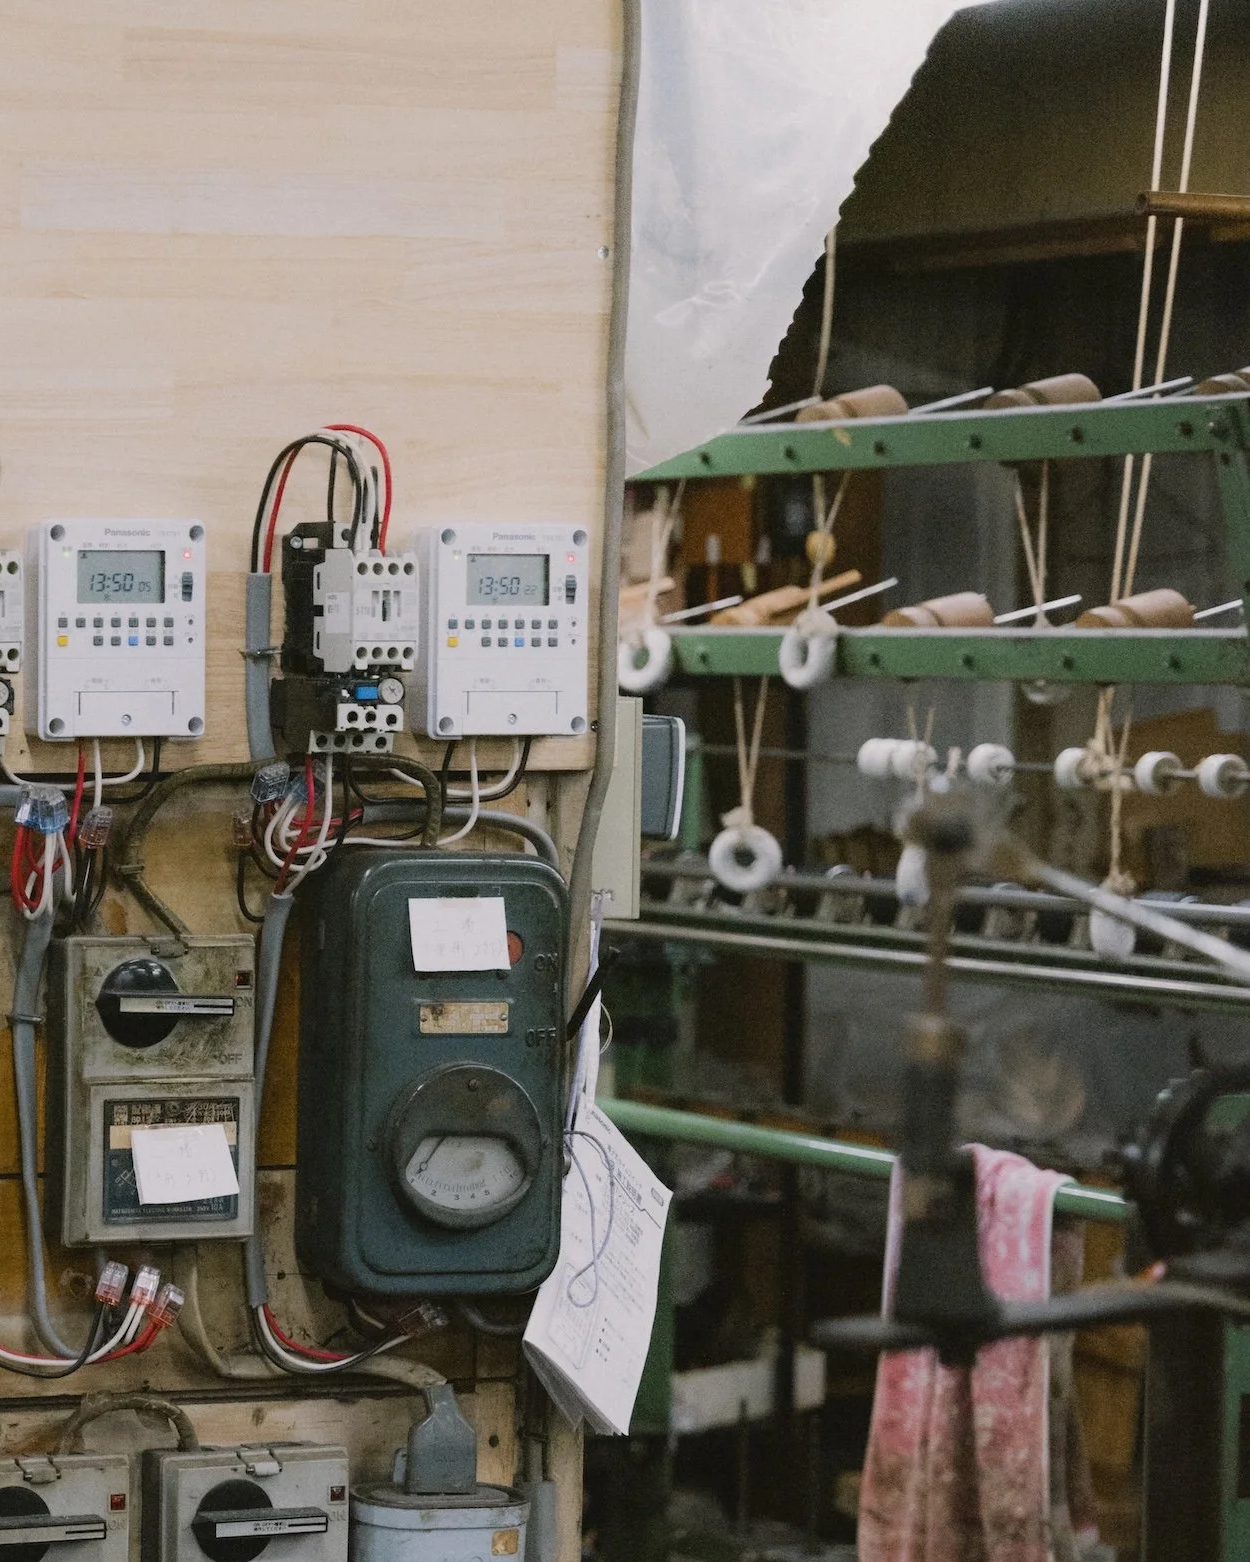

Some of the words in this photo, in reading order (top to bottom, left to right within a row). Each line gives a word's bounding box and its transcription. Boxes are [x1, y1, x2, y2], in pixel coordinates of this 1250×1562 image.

[104, 528, 151, 537] Panasonic
[492, 532, 536, 541] Panasonic
[89, 573, 135, 593] 13:50
[478, 577, 521, 596] 13:50
[534, 953, 559, 973] ON
[235, 996, 253, 1008] ON
[525, 1027, 557, 1048] OFF
[219, 1053, 243, 1065] OFF
